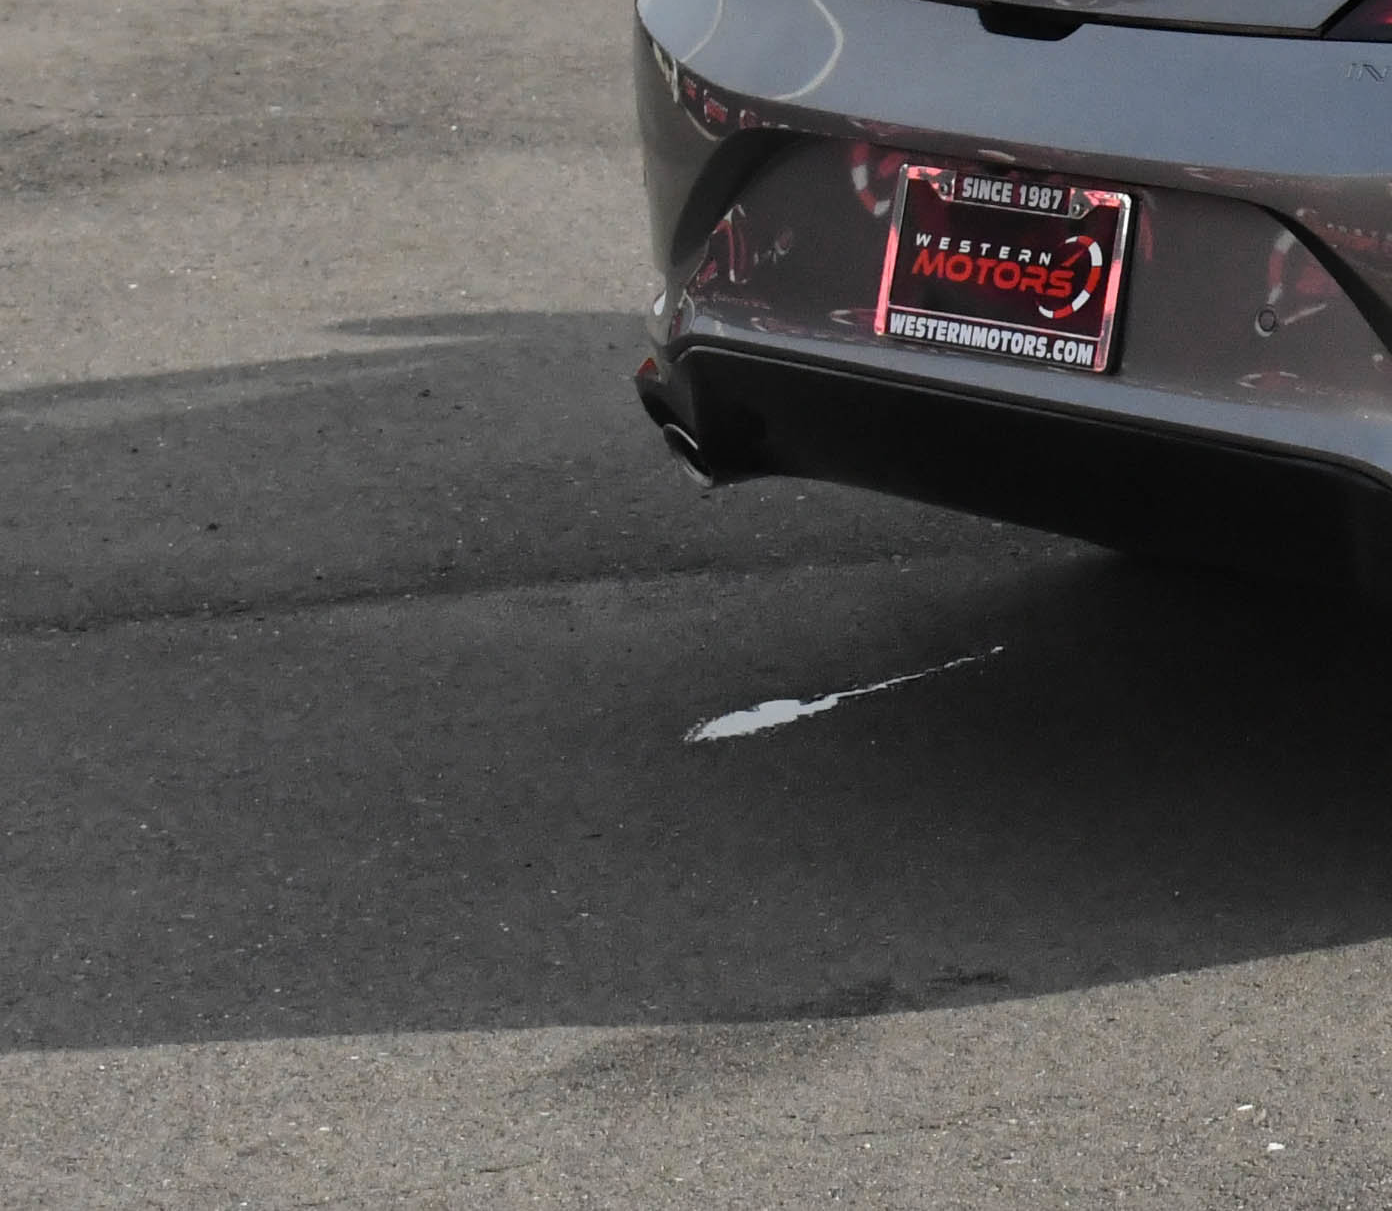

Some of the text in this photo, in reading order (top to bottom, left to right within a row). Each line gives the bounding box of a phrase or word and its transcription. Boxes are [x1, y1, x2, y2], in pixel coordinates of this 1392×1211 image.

[962, 176, 1063, 210] SINCE 1987
[915, 232, 1053, 267] WESTERN
[911, 249, 1075, 300] MOTORS
[889, 313, 1095, 365] WESTERNMOTORS.COM
